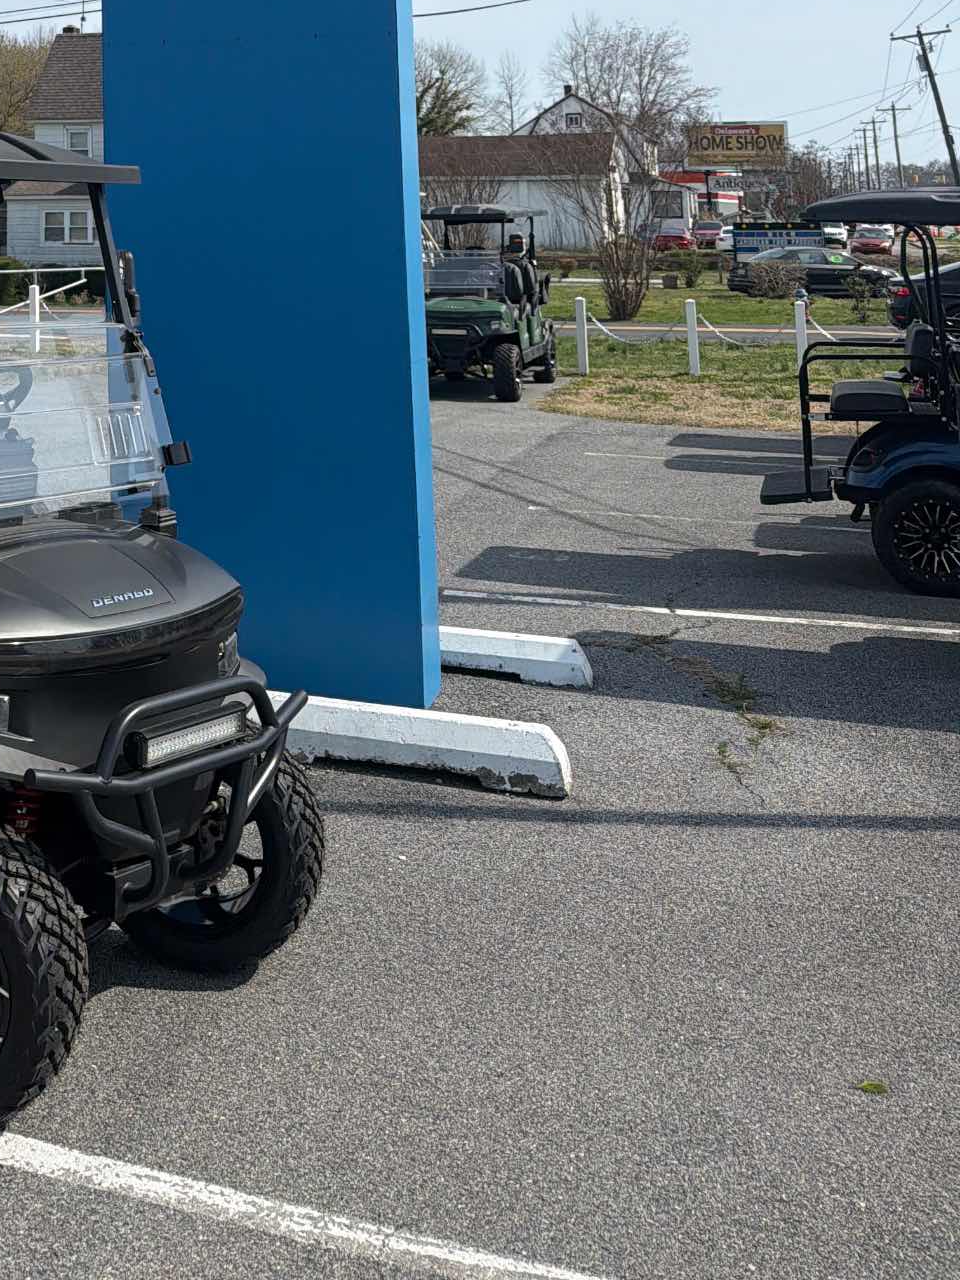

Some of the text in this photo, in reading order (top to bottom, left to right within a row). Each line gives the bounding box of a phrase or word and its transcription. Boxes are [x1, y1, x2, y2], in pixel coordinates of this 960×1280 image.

[688, 135, 785, 151] HOME SHOW
[92, 587, 154, 608] DENAGO
